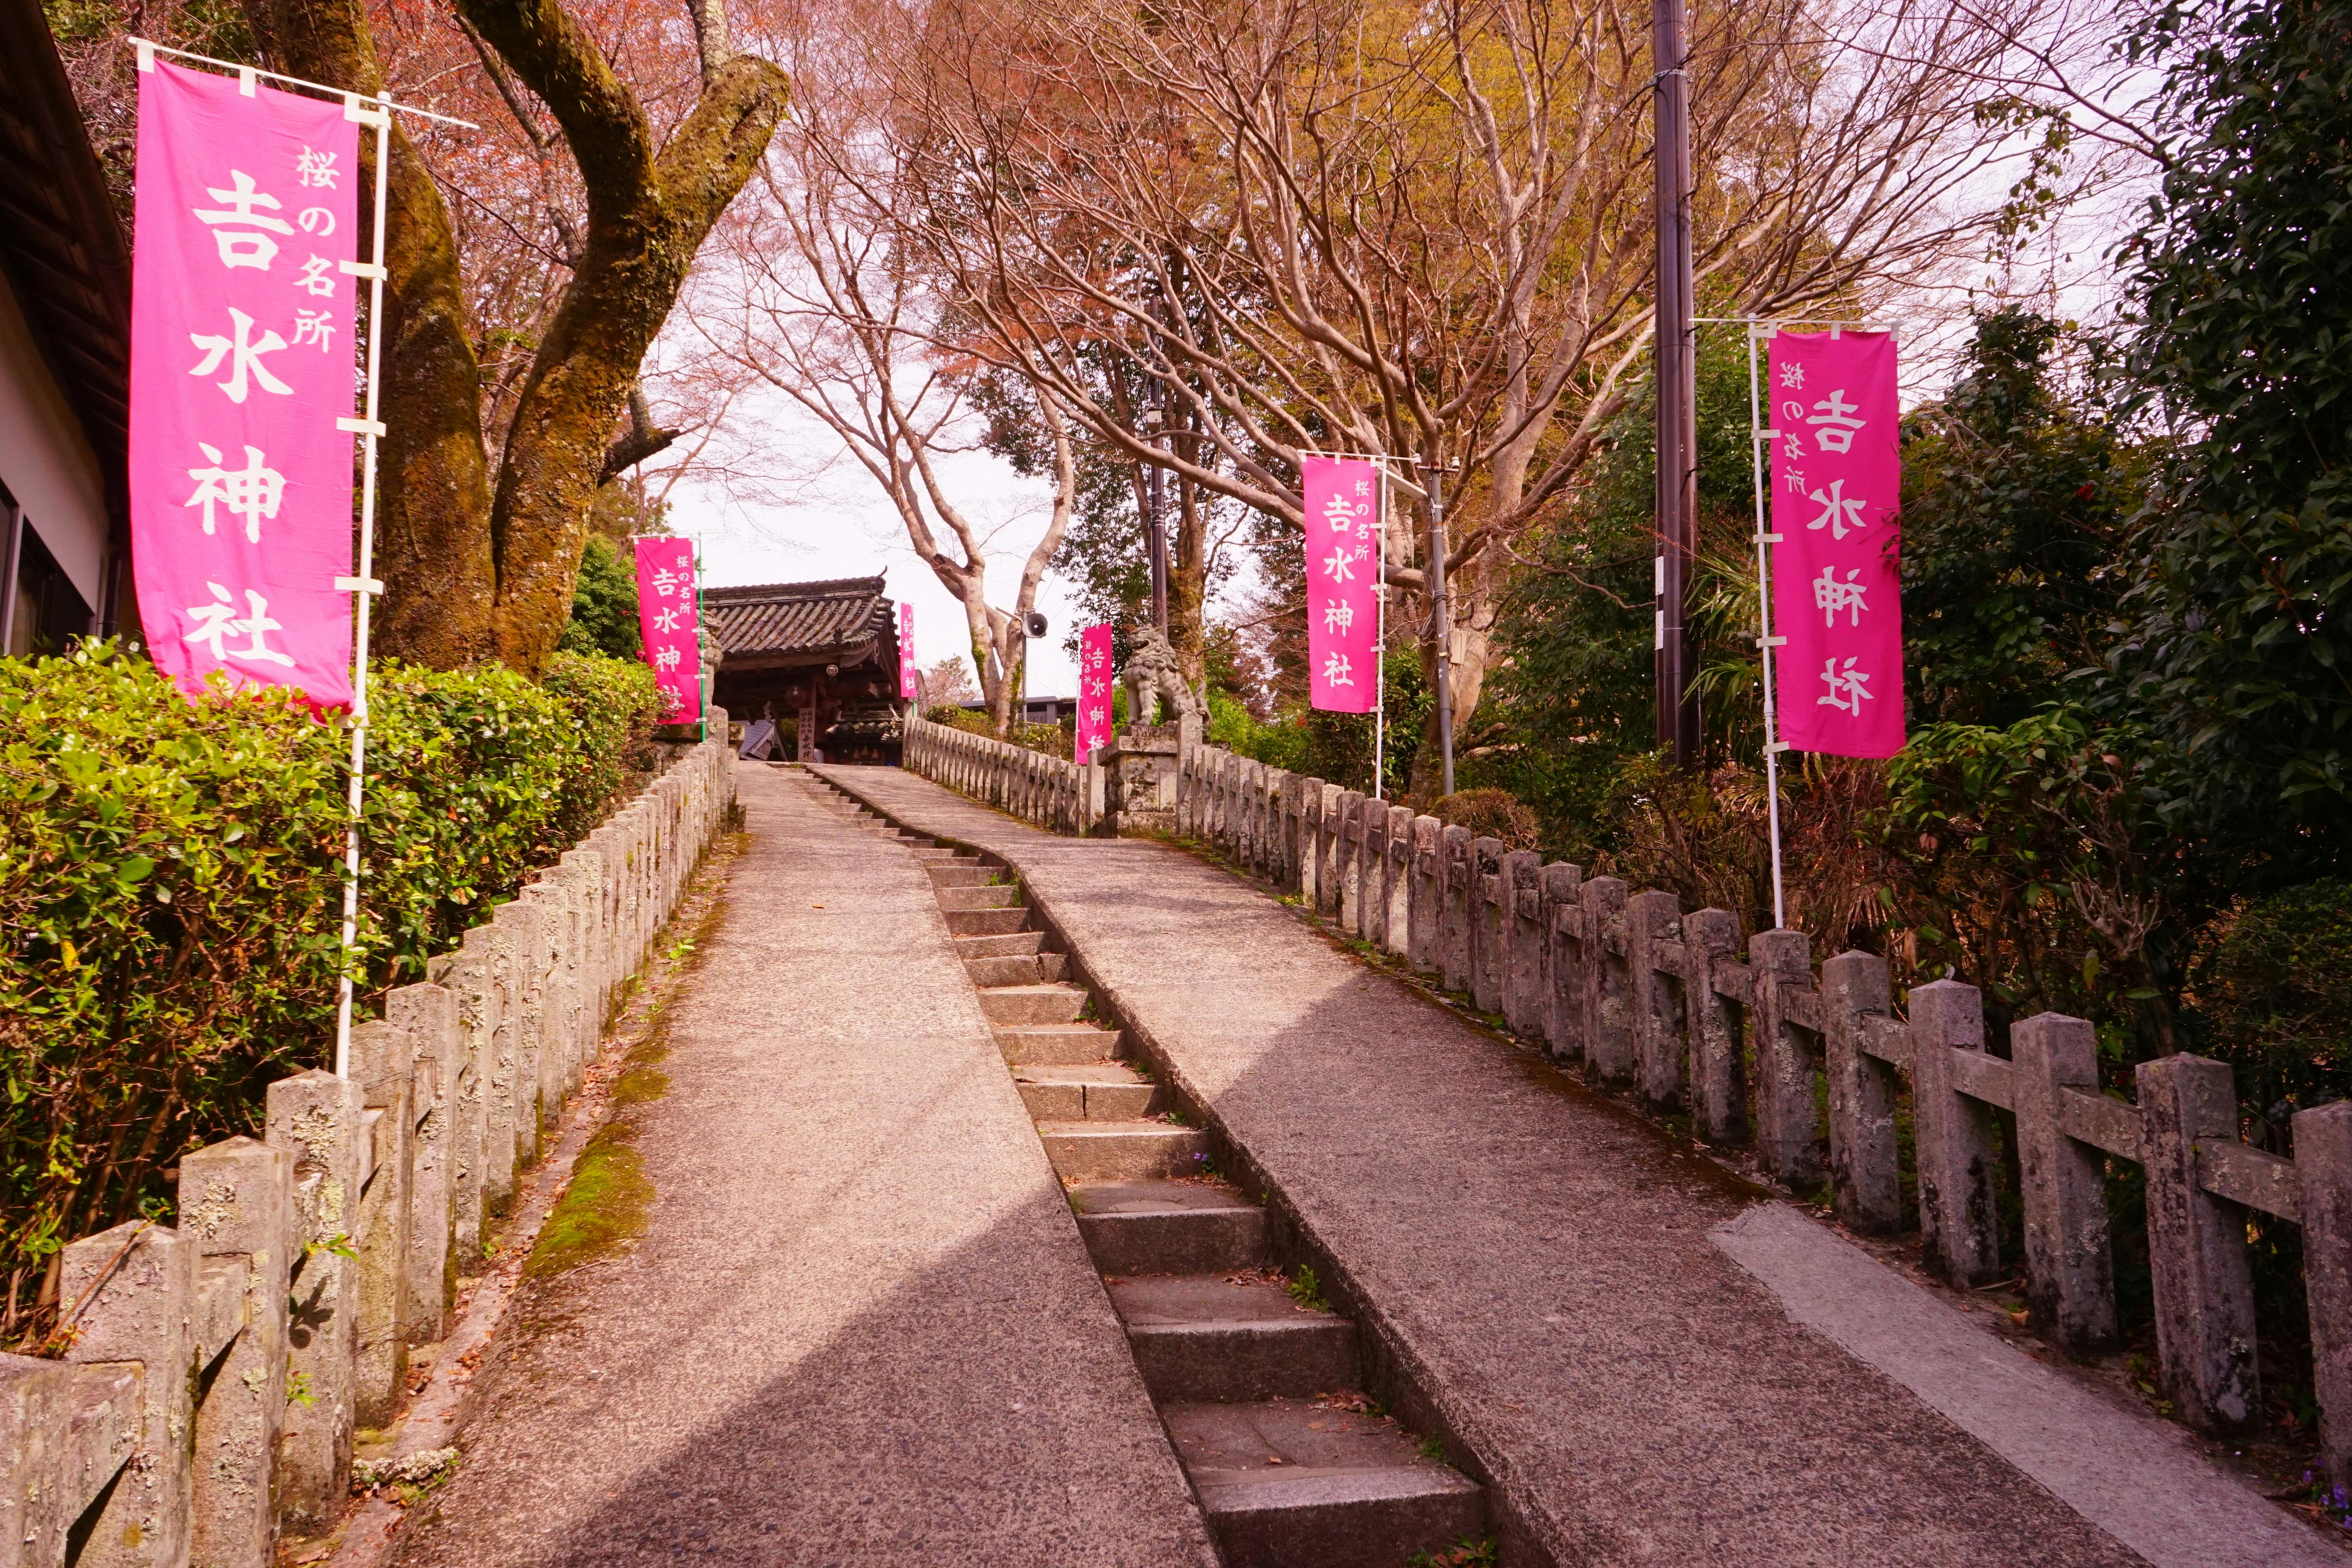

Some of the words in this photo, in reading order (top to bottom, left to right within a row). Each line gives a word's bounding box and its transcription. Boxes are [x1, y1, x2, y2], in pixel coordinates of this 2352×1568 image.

[292, 145, 340, 353] 桜の名所
[182, 169, 295, 667] 吉水神社
[676, 555, 691, 615] 桜の名所
[1322, 493, 1356, 688] 吉水神社
[1354, 479, 1370, 562] 桜の名所
